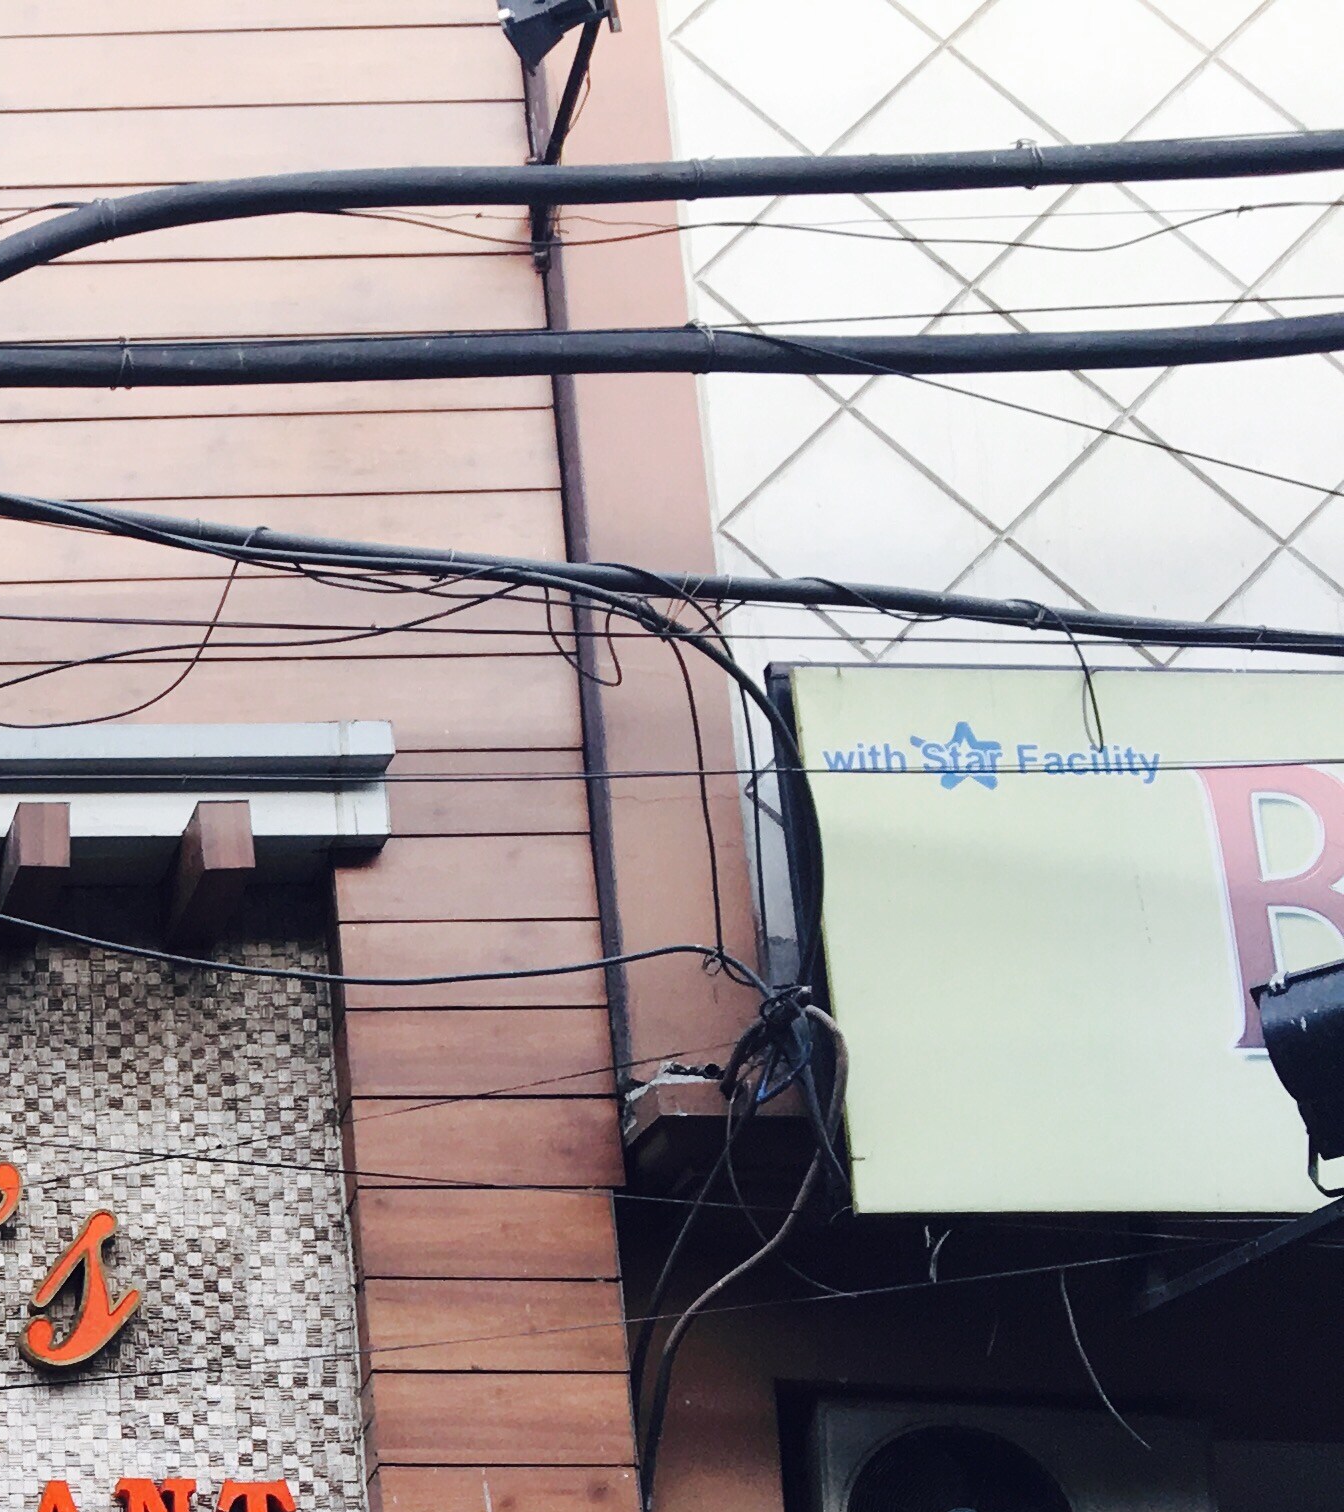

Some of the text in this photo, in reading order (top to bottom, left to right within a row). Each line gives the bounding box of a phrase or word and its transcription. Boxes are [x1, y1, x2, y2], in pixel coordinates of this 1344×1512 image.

[822, 742, 1161, 784] with Star Facility
